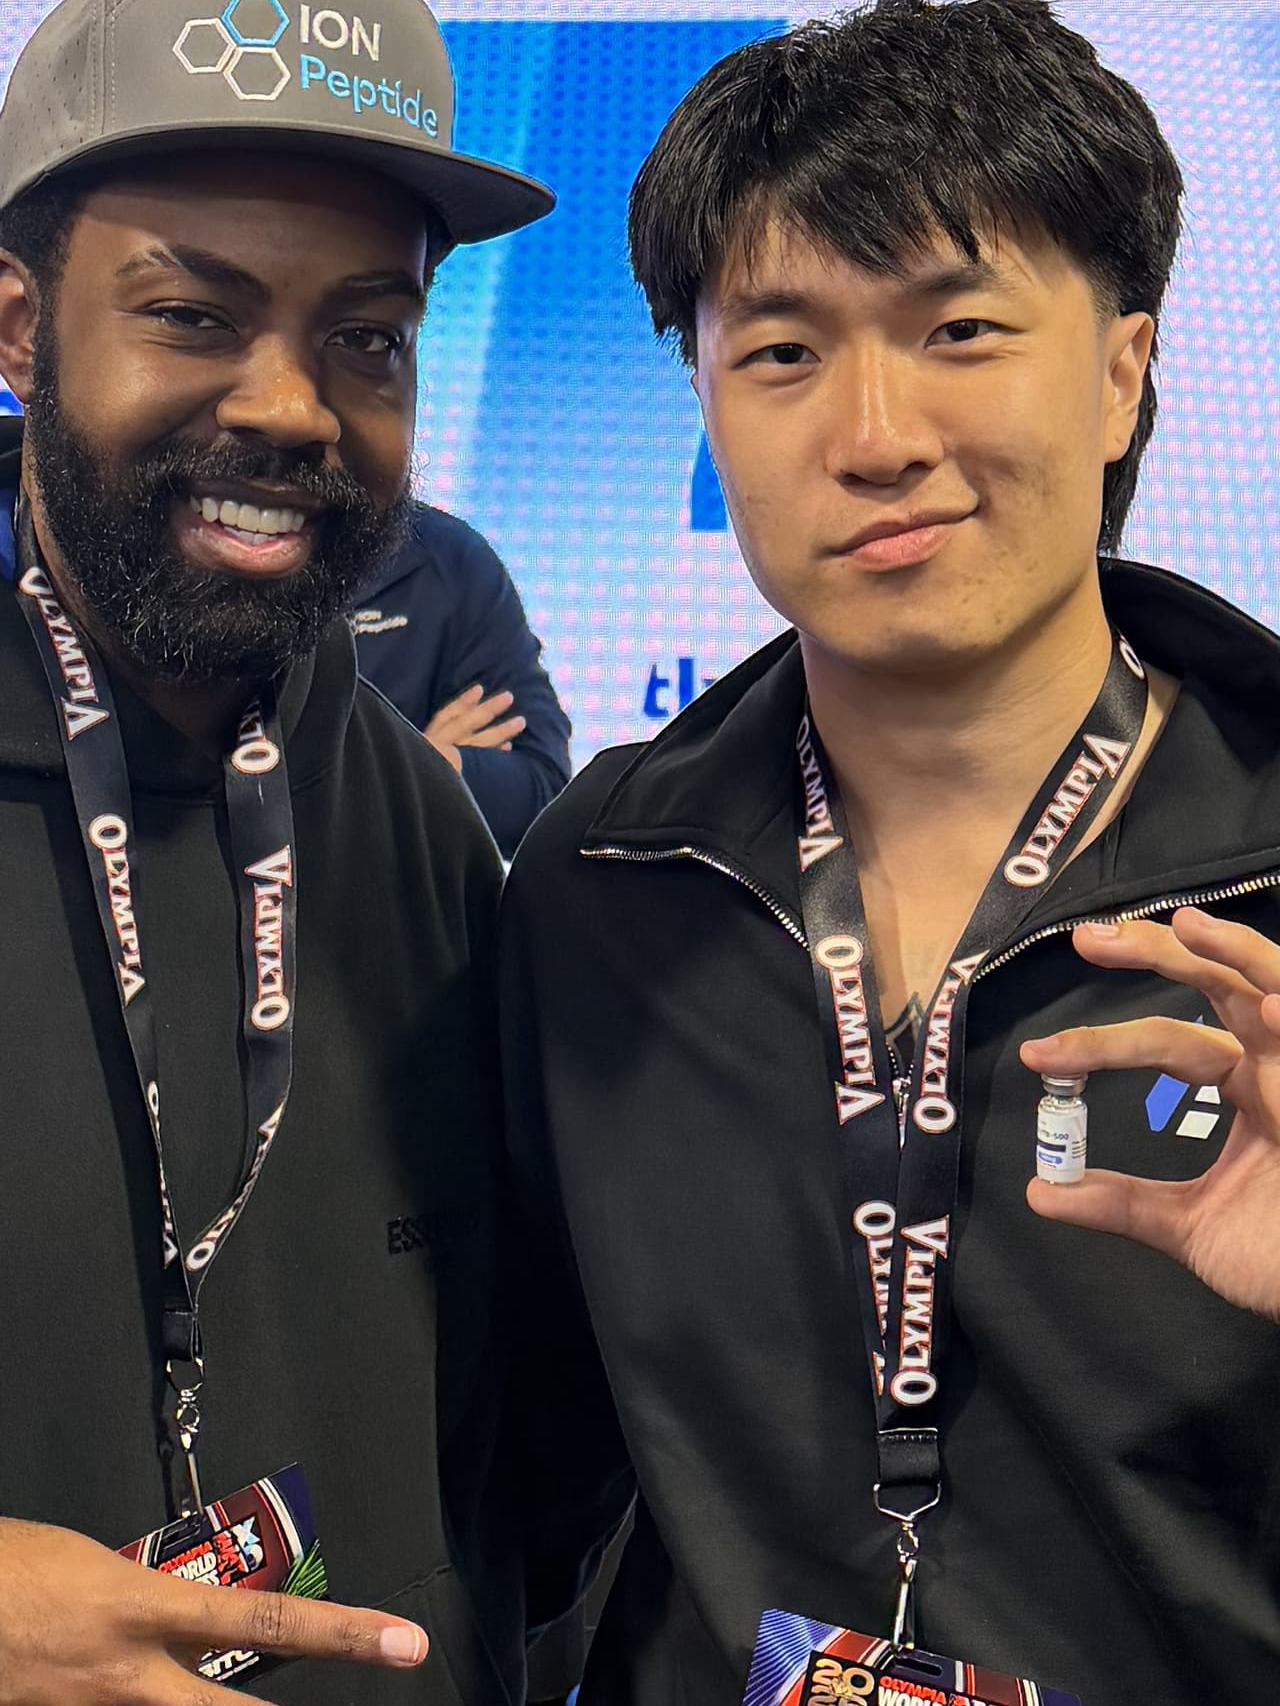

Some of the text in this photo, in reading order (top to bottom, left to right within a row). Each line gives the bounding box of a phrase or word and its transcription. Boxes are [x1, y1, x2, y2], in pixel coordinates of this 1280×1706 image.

[299, 4, 382, 61] ION
[300, 54, 438, 138] Peptide
[19, 566, 110, 741] OLYMPIA
[796, 715, 844, 873] OLYMPIA
[1004, 734, 1131, 887] OLYMPIA
[88, 812, 145, 1007] OLYMPIA
[243, 844, 293, 1031] OLYMPIA
[815, 934, 886, 1125] OLYMPIA
[913, 949, 990, 1135] OLYMPIA
[889, 1214, 951, 1408] OLYMPIA
[879, 1675, 947, 1705] OLYMPIA
